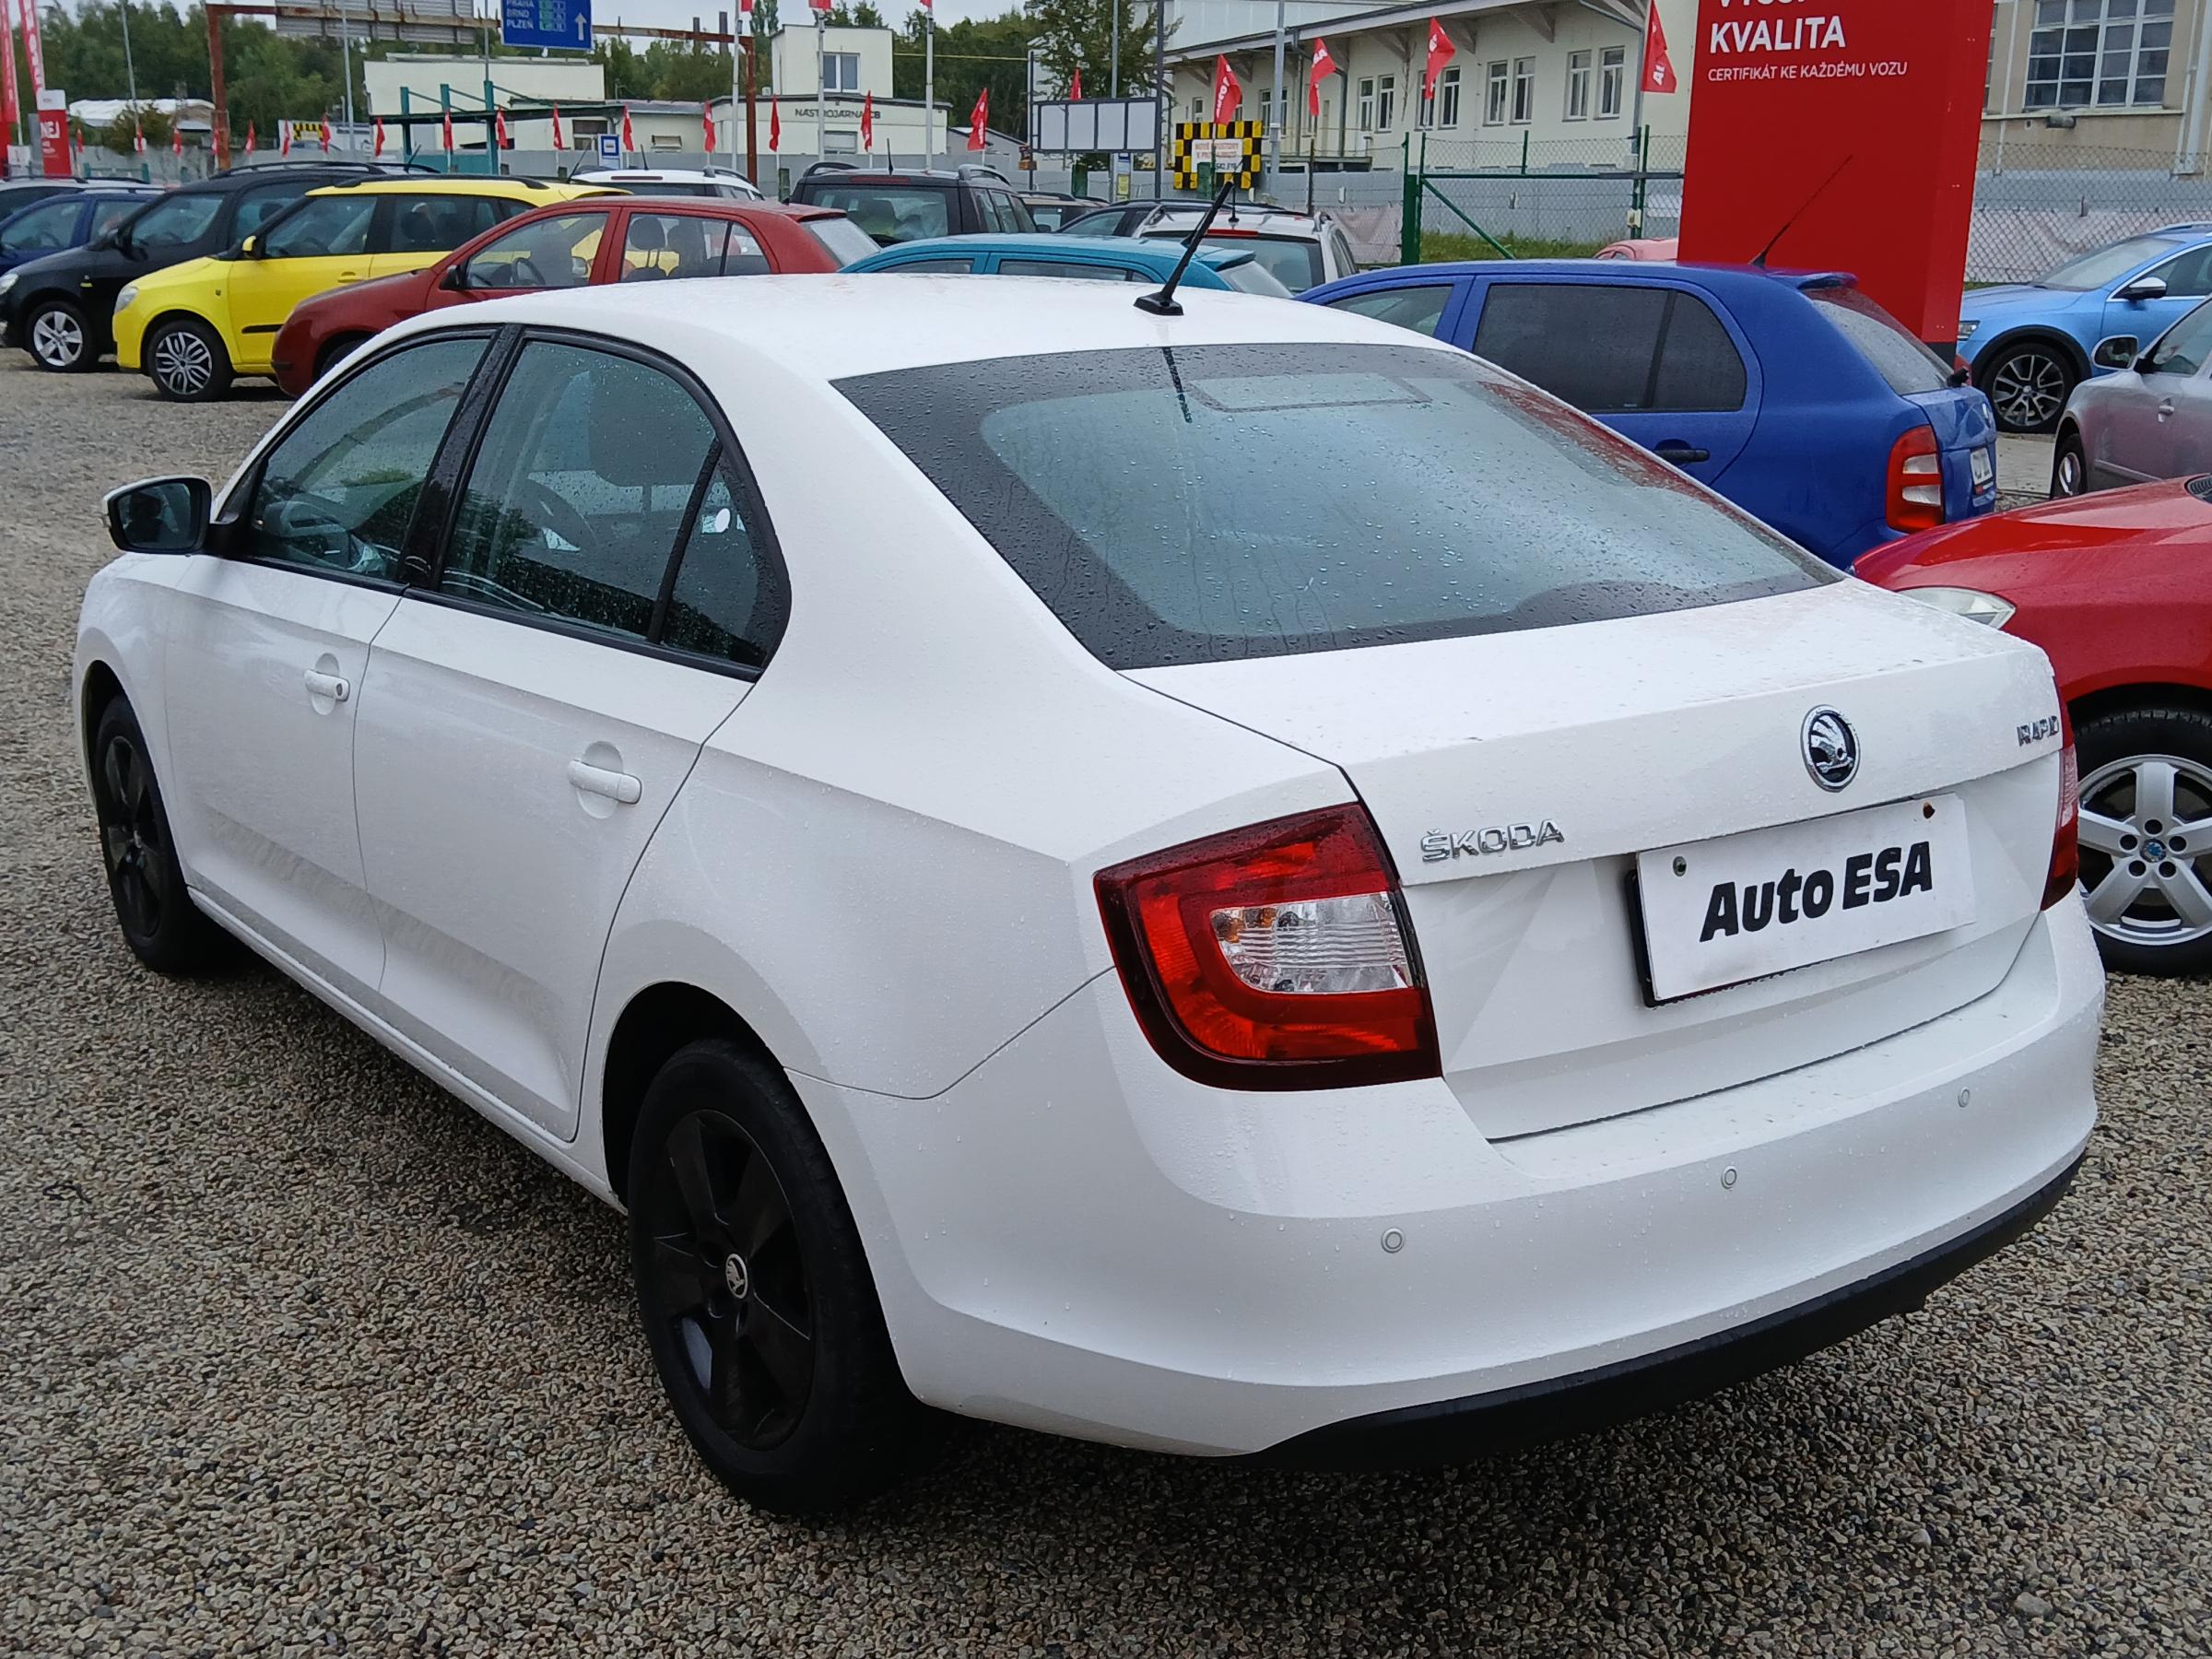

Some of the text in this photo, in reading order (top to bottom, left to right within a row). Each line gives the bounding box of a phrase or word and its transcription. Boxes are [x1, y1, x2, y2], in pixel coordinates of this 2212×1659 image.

[506, 8, 530, 18] BRNO
[1710, 16, 1846, 53] KVALITA
[1708, 61, 1907, 81] CERTIFIKÁT KE KAŽDÉMU VOZU
[2016, 715, 2060, 747] RAPID
[1420, 818, 1565, 863] ŠKODA
[1699, 841, 1933, 943] Auto ESA
